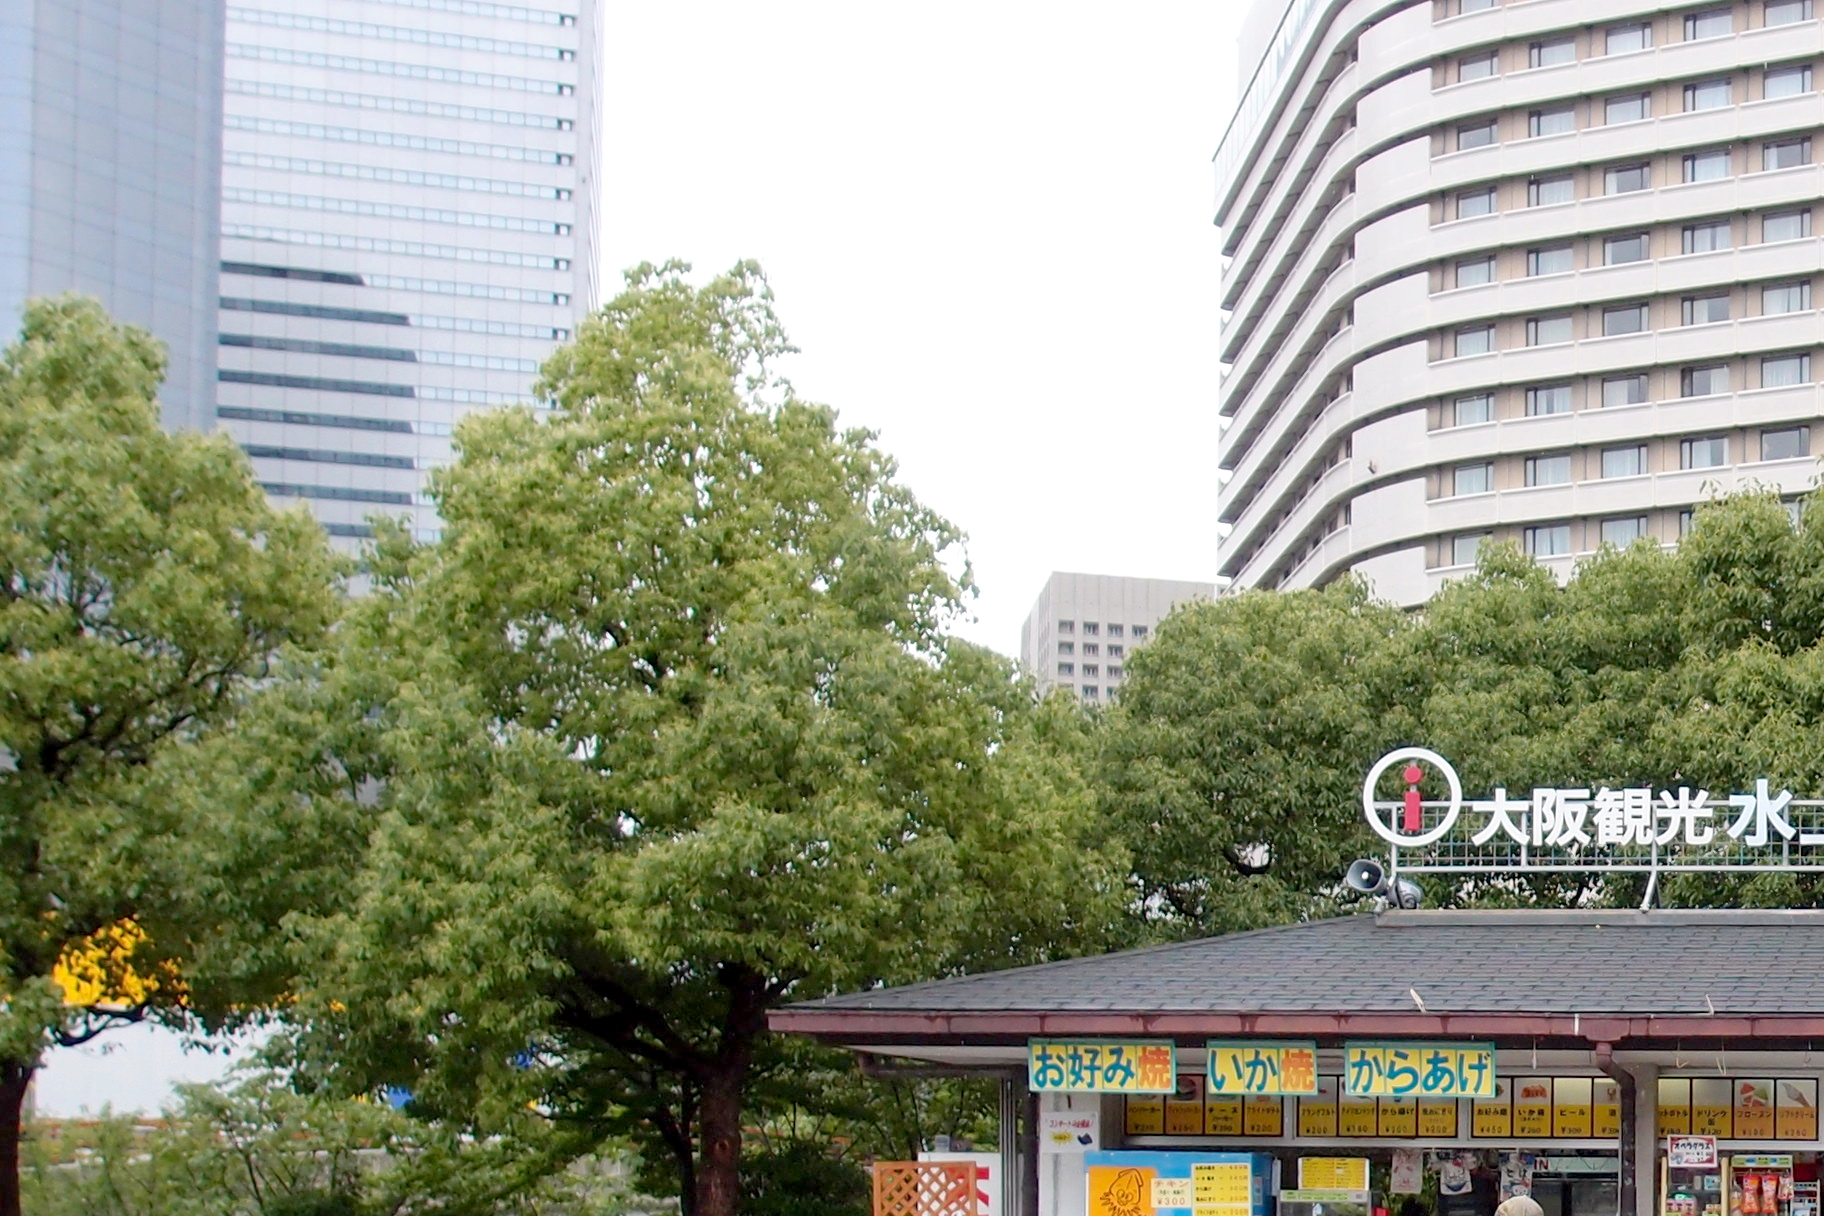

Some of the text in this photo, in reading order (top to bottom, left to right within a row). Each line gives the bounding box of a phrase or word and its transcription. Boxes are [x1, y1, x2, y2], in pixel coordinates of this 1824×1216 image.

[1471, 786, 1713, 847] 大阪観光
[1034, 1046, 1172, 1089] お好み焼
[1211, 1049, 1315, 1092] いか焼
[1351, 1050, 1491, 1093] からあげ
[1560, 1109, 1586, 1117] ビール
